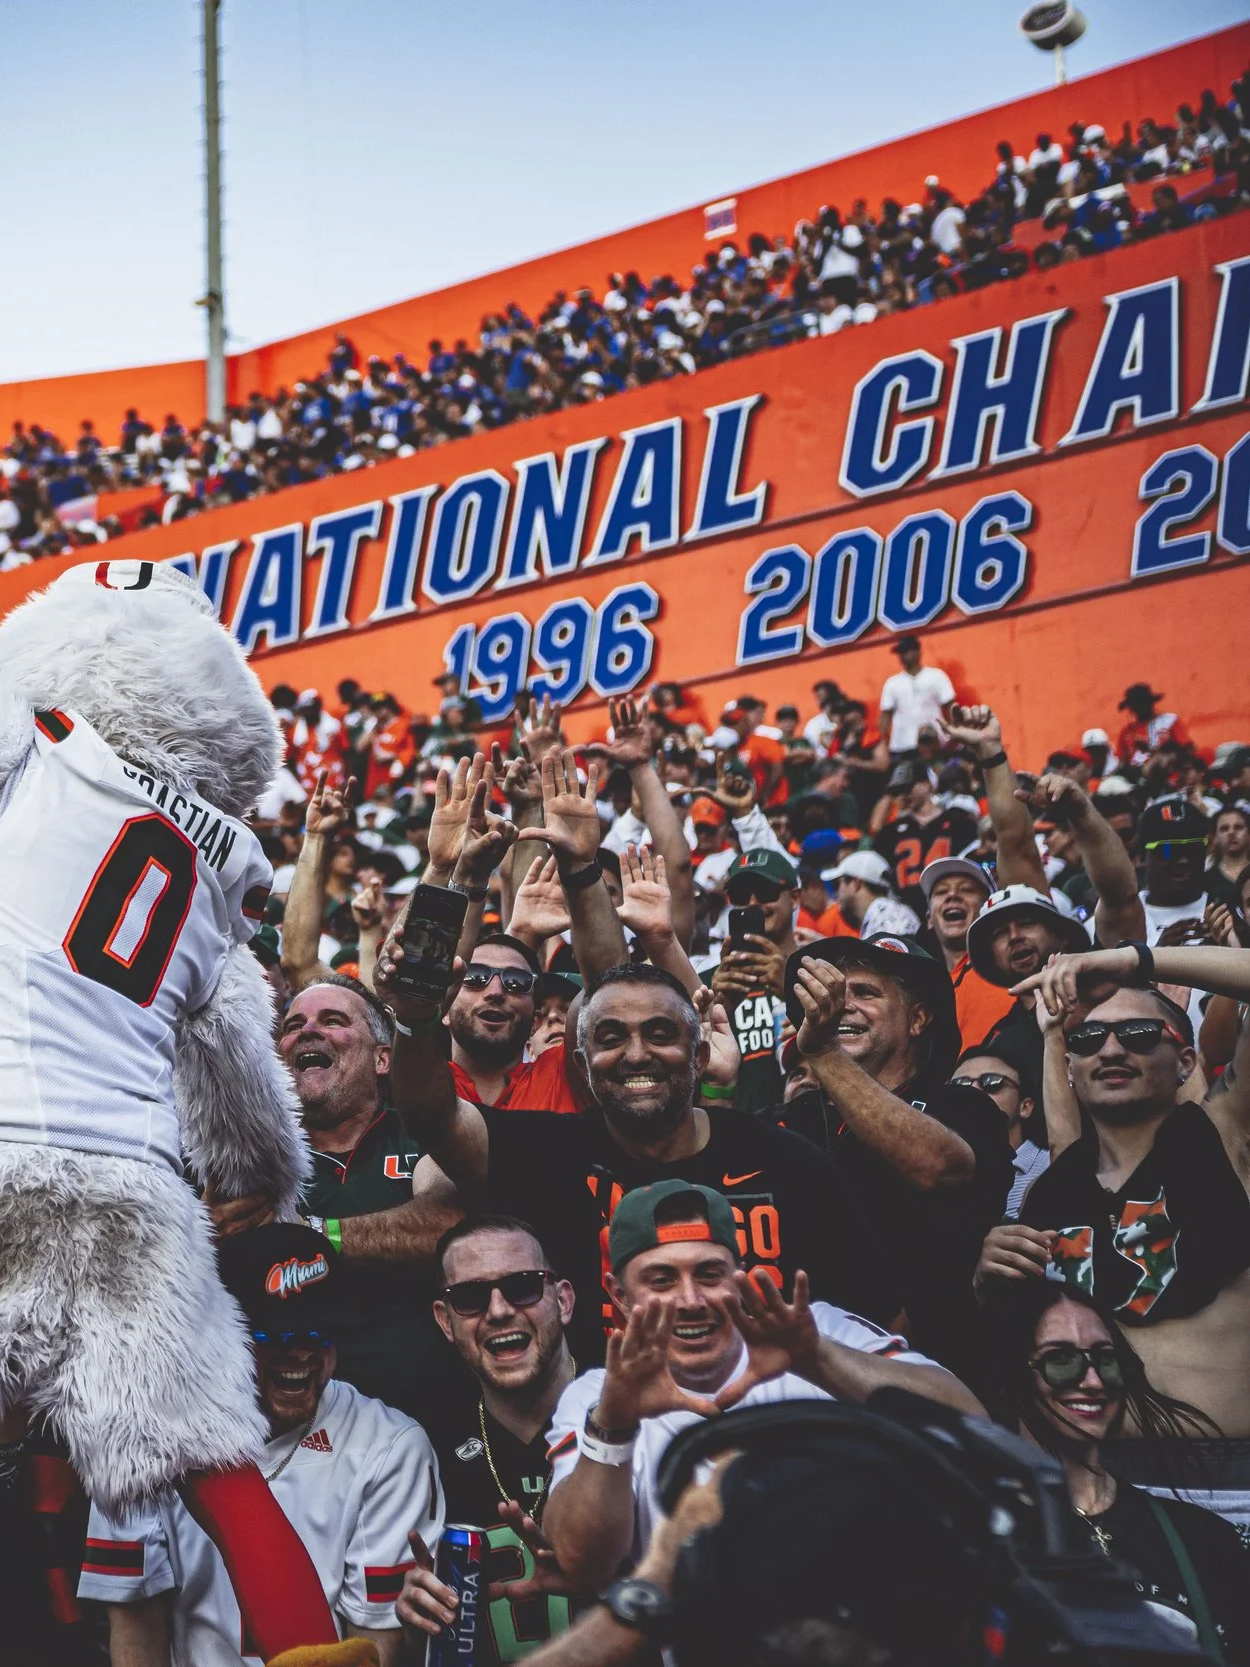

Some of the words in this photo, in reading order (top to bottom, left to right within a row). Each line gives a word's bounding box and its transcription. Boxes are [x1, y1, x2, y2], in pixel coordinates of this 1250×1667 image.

[736, 490, 1032, 667] 2006
[443, 581, 659, 724] 1996
[62, 811, 198, 1008] 0
[266, 1254, 329, 1298] Miami
[300, 1440, 333, 1453] adidas
[521, 1475, 544, 1494] U
[457, 1571, 480, 1654] ULTRA
